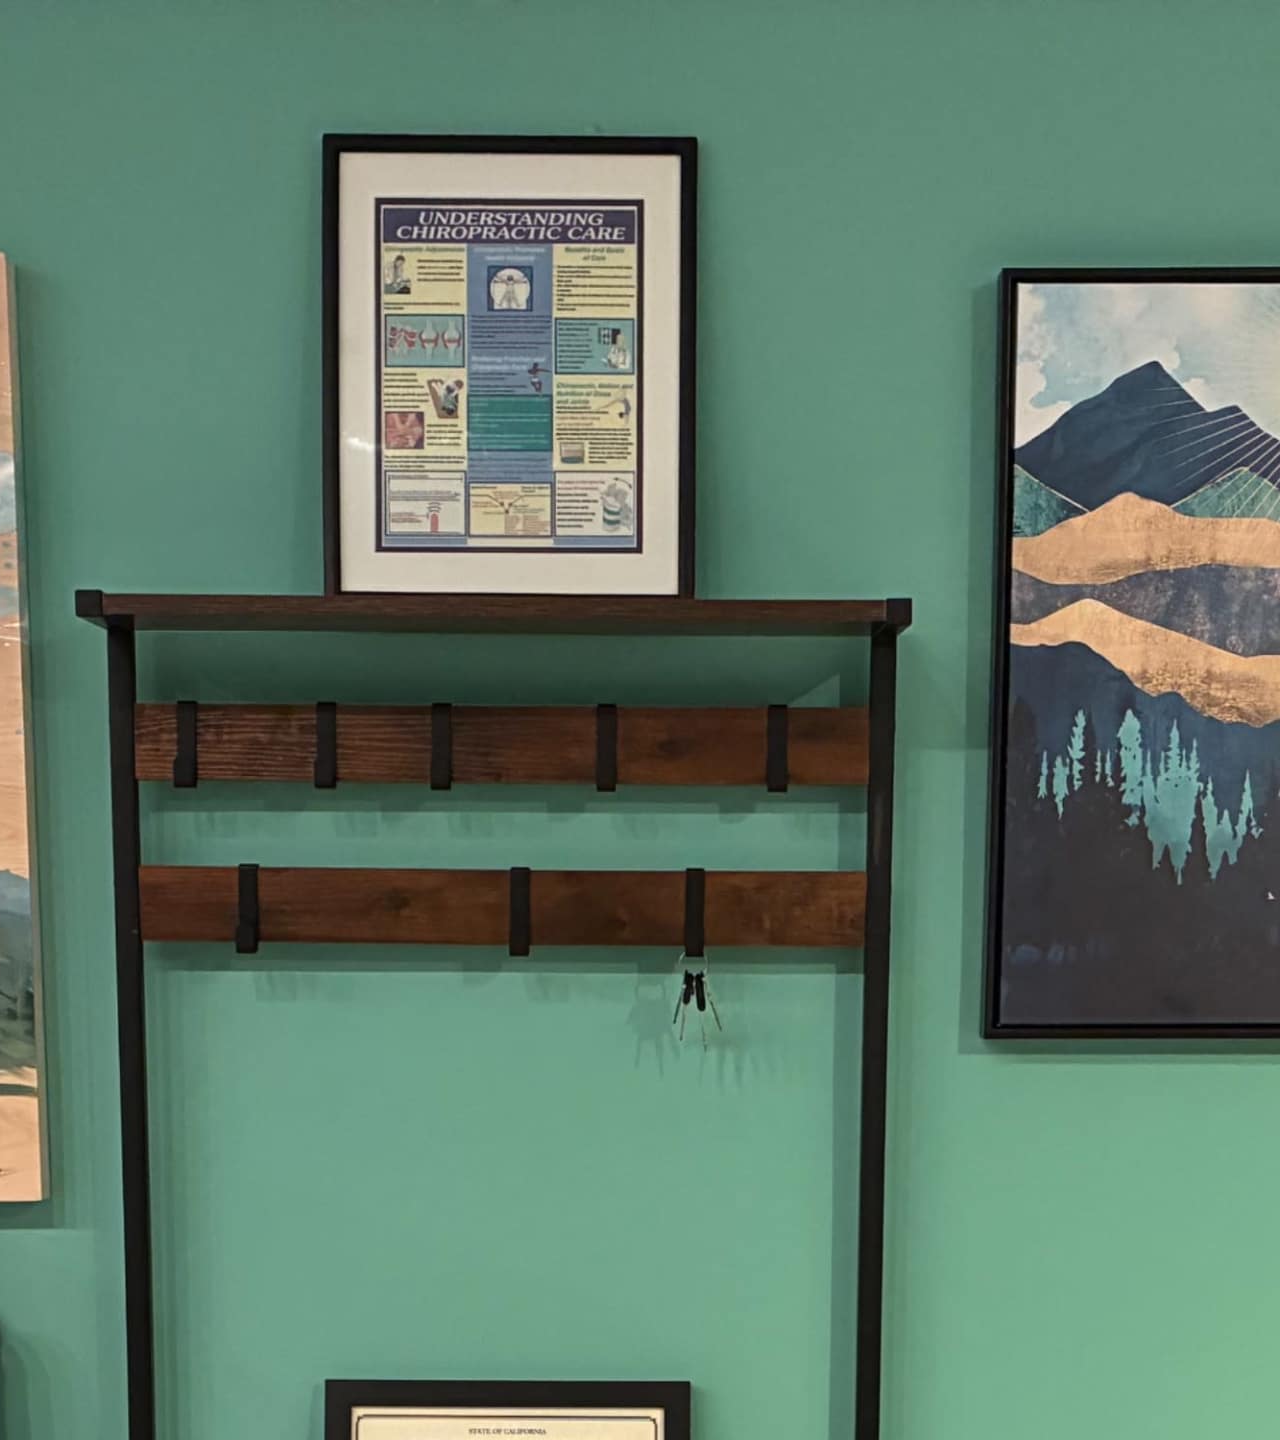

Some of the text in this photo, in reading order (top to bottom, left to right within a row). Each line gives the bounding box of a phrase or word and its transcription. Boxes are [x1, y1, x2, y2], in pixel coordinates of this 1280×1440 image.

[419, 210, 604, 226] UNDERSTANDING
[396, 225, 626, 240] CHIROPRACTIC CARE
